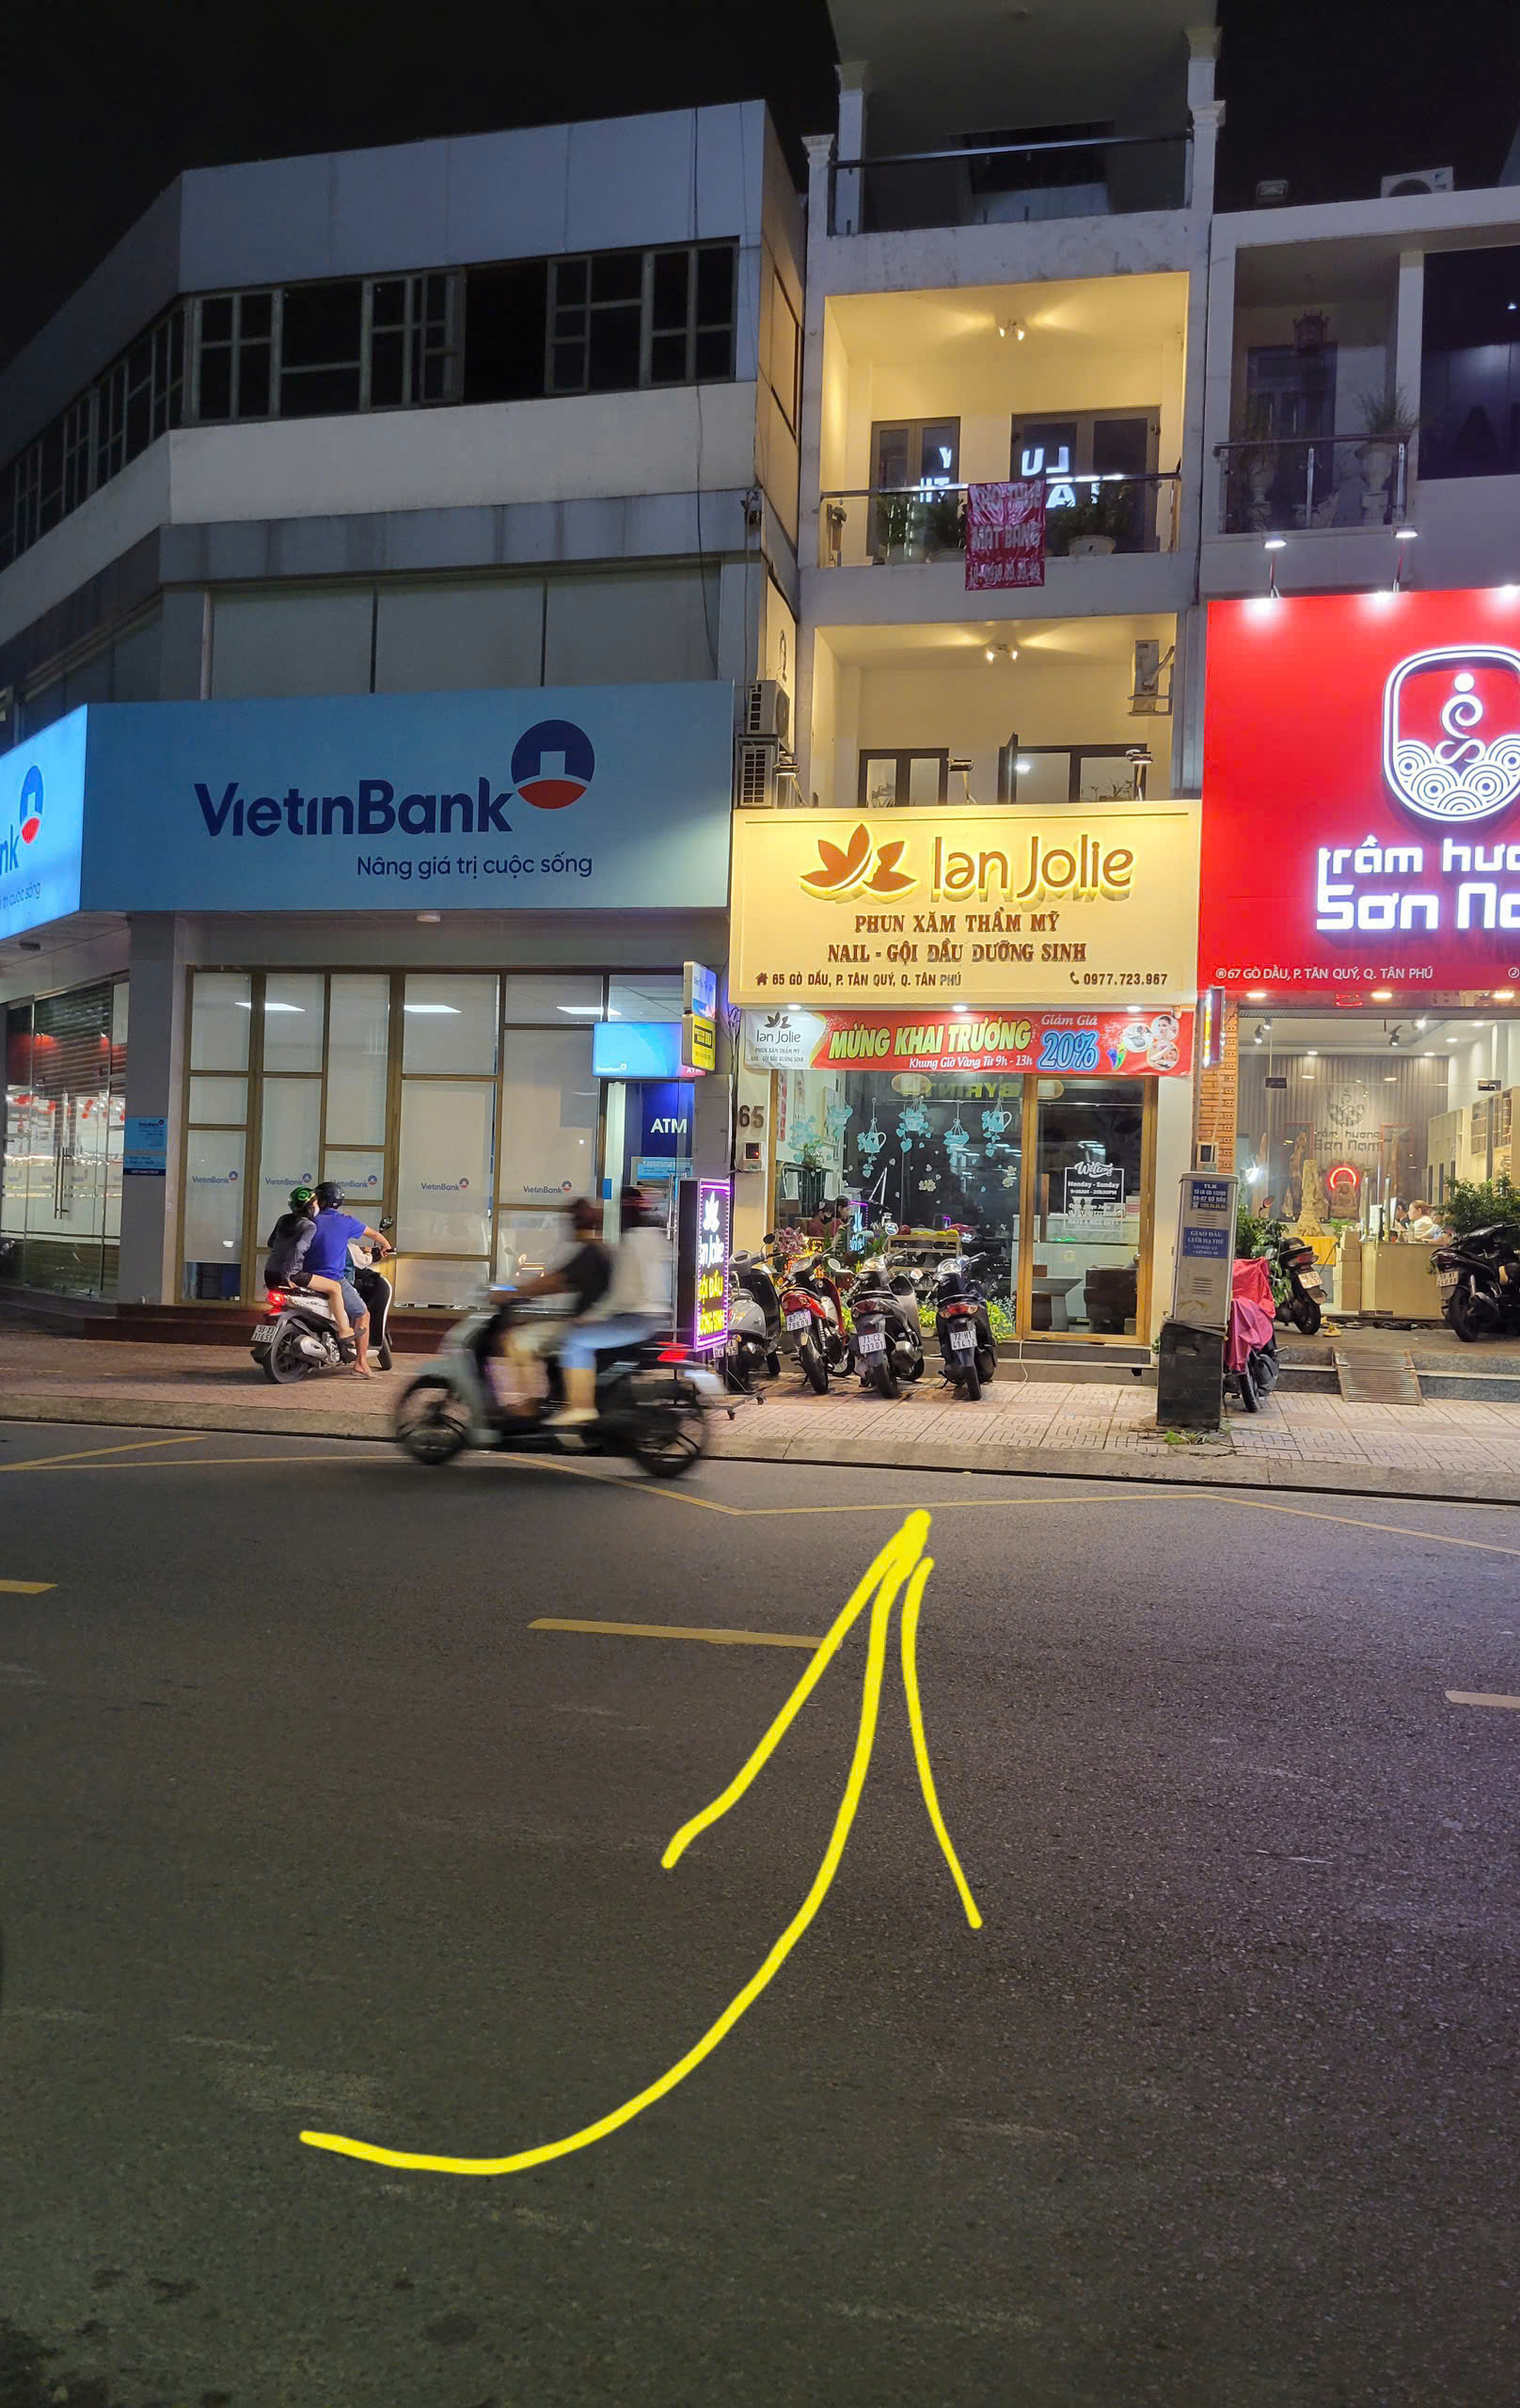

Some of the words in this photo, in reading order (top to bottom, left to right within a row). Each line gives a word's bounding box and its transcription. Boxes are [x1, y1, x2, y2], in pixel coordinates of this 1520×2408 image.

[194, 777, 514, 837] VietinBank
[356, 856, 412, 880] Nâng
[418, 854, 451, 879] giá
[456, 855, 477, 879] trị
[483, 853, 534, 879] cuộc
[540, 850, 593, 879] sống
[1016, 833, 1133, 898] Jolie
[855, 914, 905, 933] PHUN
[912, 911, 957, 933] XĂM
[965, 907, 1021, 933] THẨM
[1030, 910, 1060, 933] MỸ
[828, 944, 870, 963] NAIL
[886, 941, 918, 966] GỘI
[926, 938, 964, 963] ĐẦU
[972, 940, 1035, 963] DƯỠNG
[1040, 943, 1087, 962] SINH
[772, 974, 784, 986] 65
[789, 971, 802, 986] GÒ
[835, 974, 844, 986] P.
[847, 972, 868, 986] TÂN
[900, 974, 910, 987] Q.
[915, 972, 936, 986] TÂN
[940, 971, 962, 986] PHÚ
[1084, 973, 1168, 986] 0977.723.967
[1227, 969, 1242, 979] 67
[1243, 966, 1260, 979] GÒ
[1304, 966, 1328, 979] TÂN
[1364, 968, 1376, 980] Q.
[1380, 966, 1403, 979] TÂN
[1408, 966, 1433, 979] PHÚ
[1077, 1013, 1098, 1026] Giá
[775, 1031, 801, 1045] Jolie
[828, 1021, 891, 1060] MỪNG
[894, 1023, 944, 1056] KHAI
[947, 1015, 1032, 1054] TRƯƠNG
[1039, 1030, 1099, 1069] 20%
[909, 1056, 939, 1070] Khung
[940, 1055, 957, 1069] Giờ
[958, 1054, 981, 1070] Vàng
[995, 1054, 1007, 1067] 9h
[1016, 1054, 1033, 1067] 13h
[738, 1104, 765, 1129] 65
[650, 1118, 688, 1134] ATM
[420, 1182, 460, 1191] VietinBank
[522, 1185, 562, 1195] VietinBank
